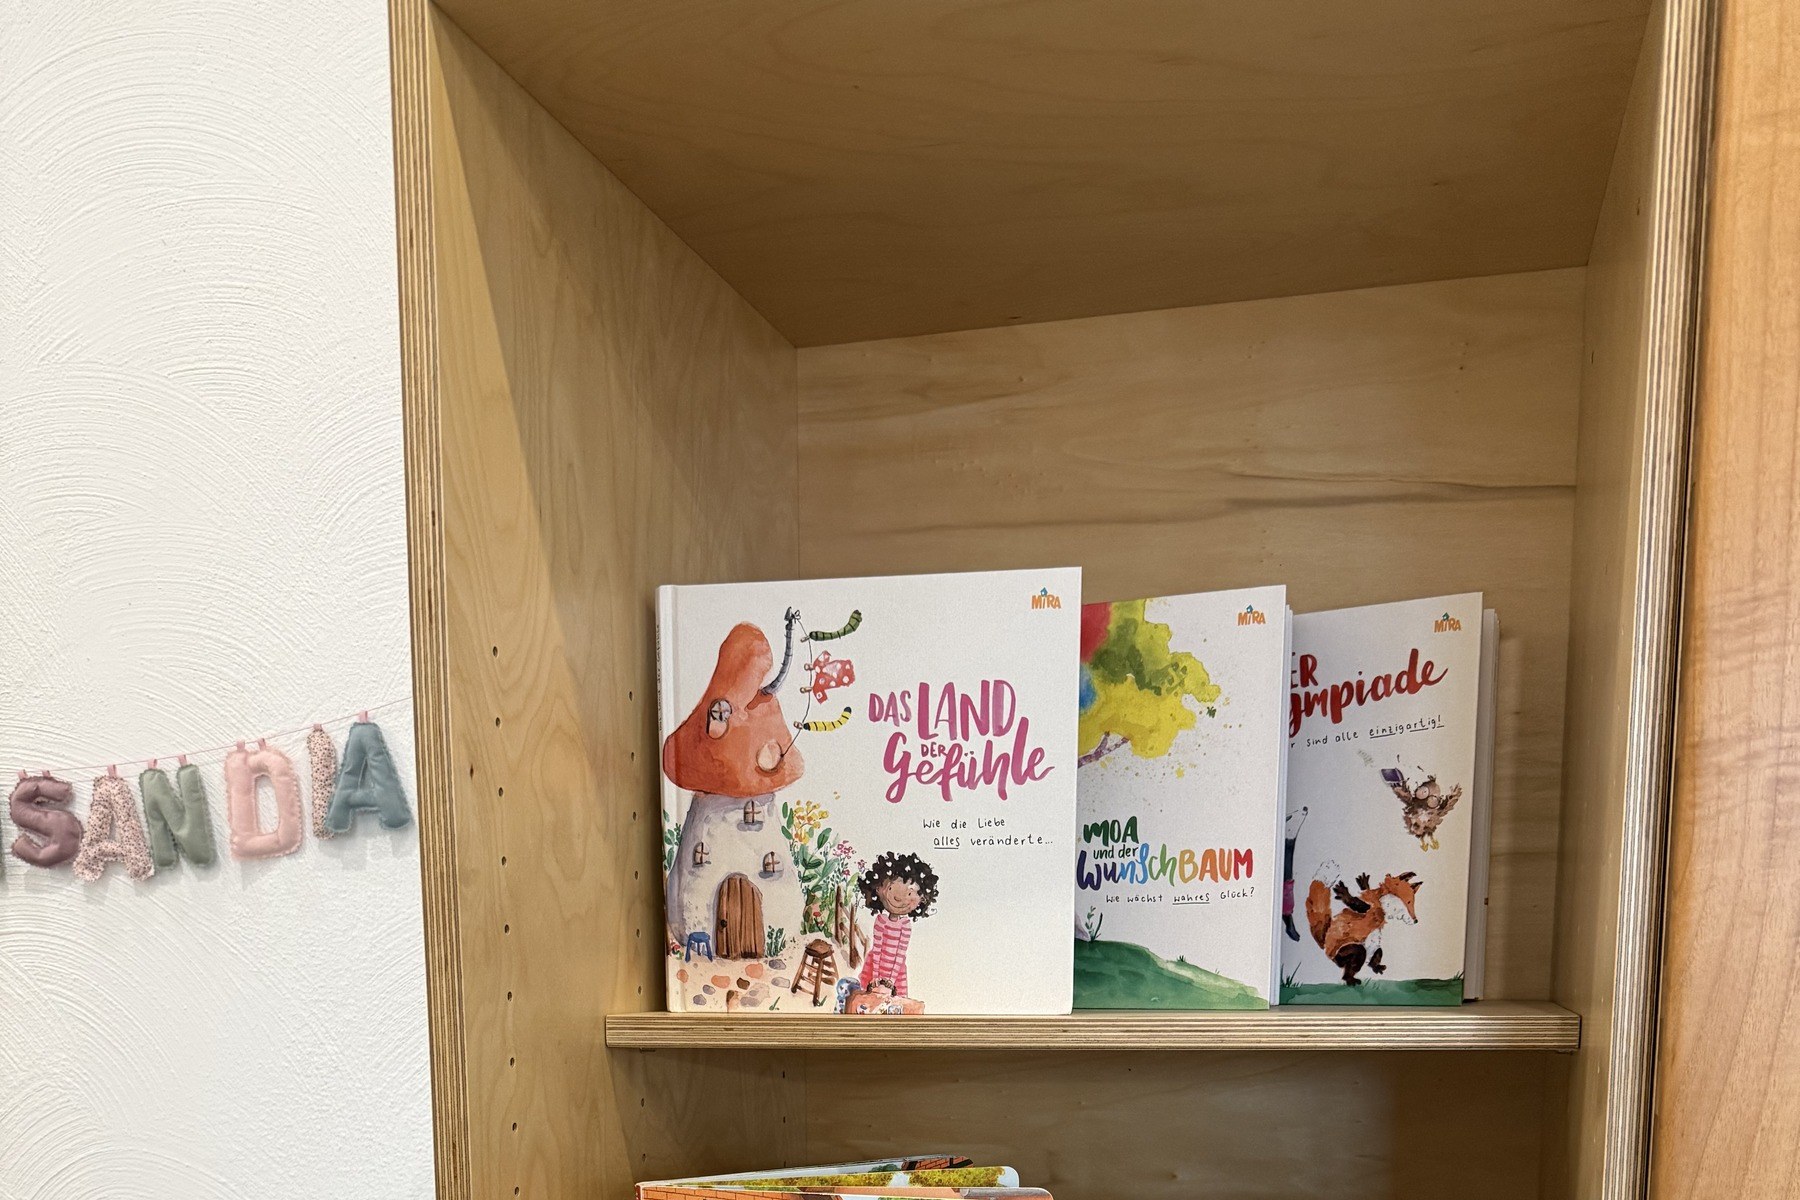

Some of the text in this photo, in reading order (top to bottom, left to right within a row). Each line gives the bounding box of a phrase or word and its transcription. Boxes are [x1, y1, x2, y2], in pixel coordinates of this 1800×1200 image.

[868, 679, 1016, 742] DAS LAND
[1335, 730, 1359, 743] alle
[1369, 714, 1444, 737] einzigartig!
[920, 742, 950, 758] DER
[883, 716, 1056, 804] Gefühle
[923, 817, 1005, 830] Wie die Liebe
[933, 835, 960, 848] alles
[1093, 844, 1139, 860] und der
[1173, 892, 1210, 903] wahres
[1220, 886, 1255, 900] Glück?
